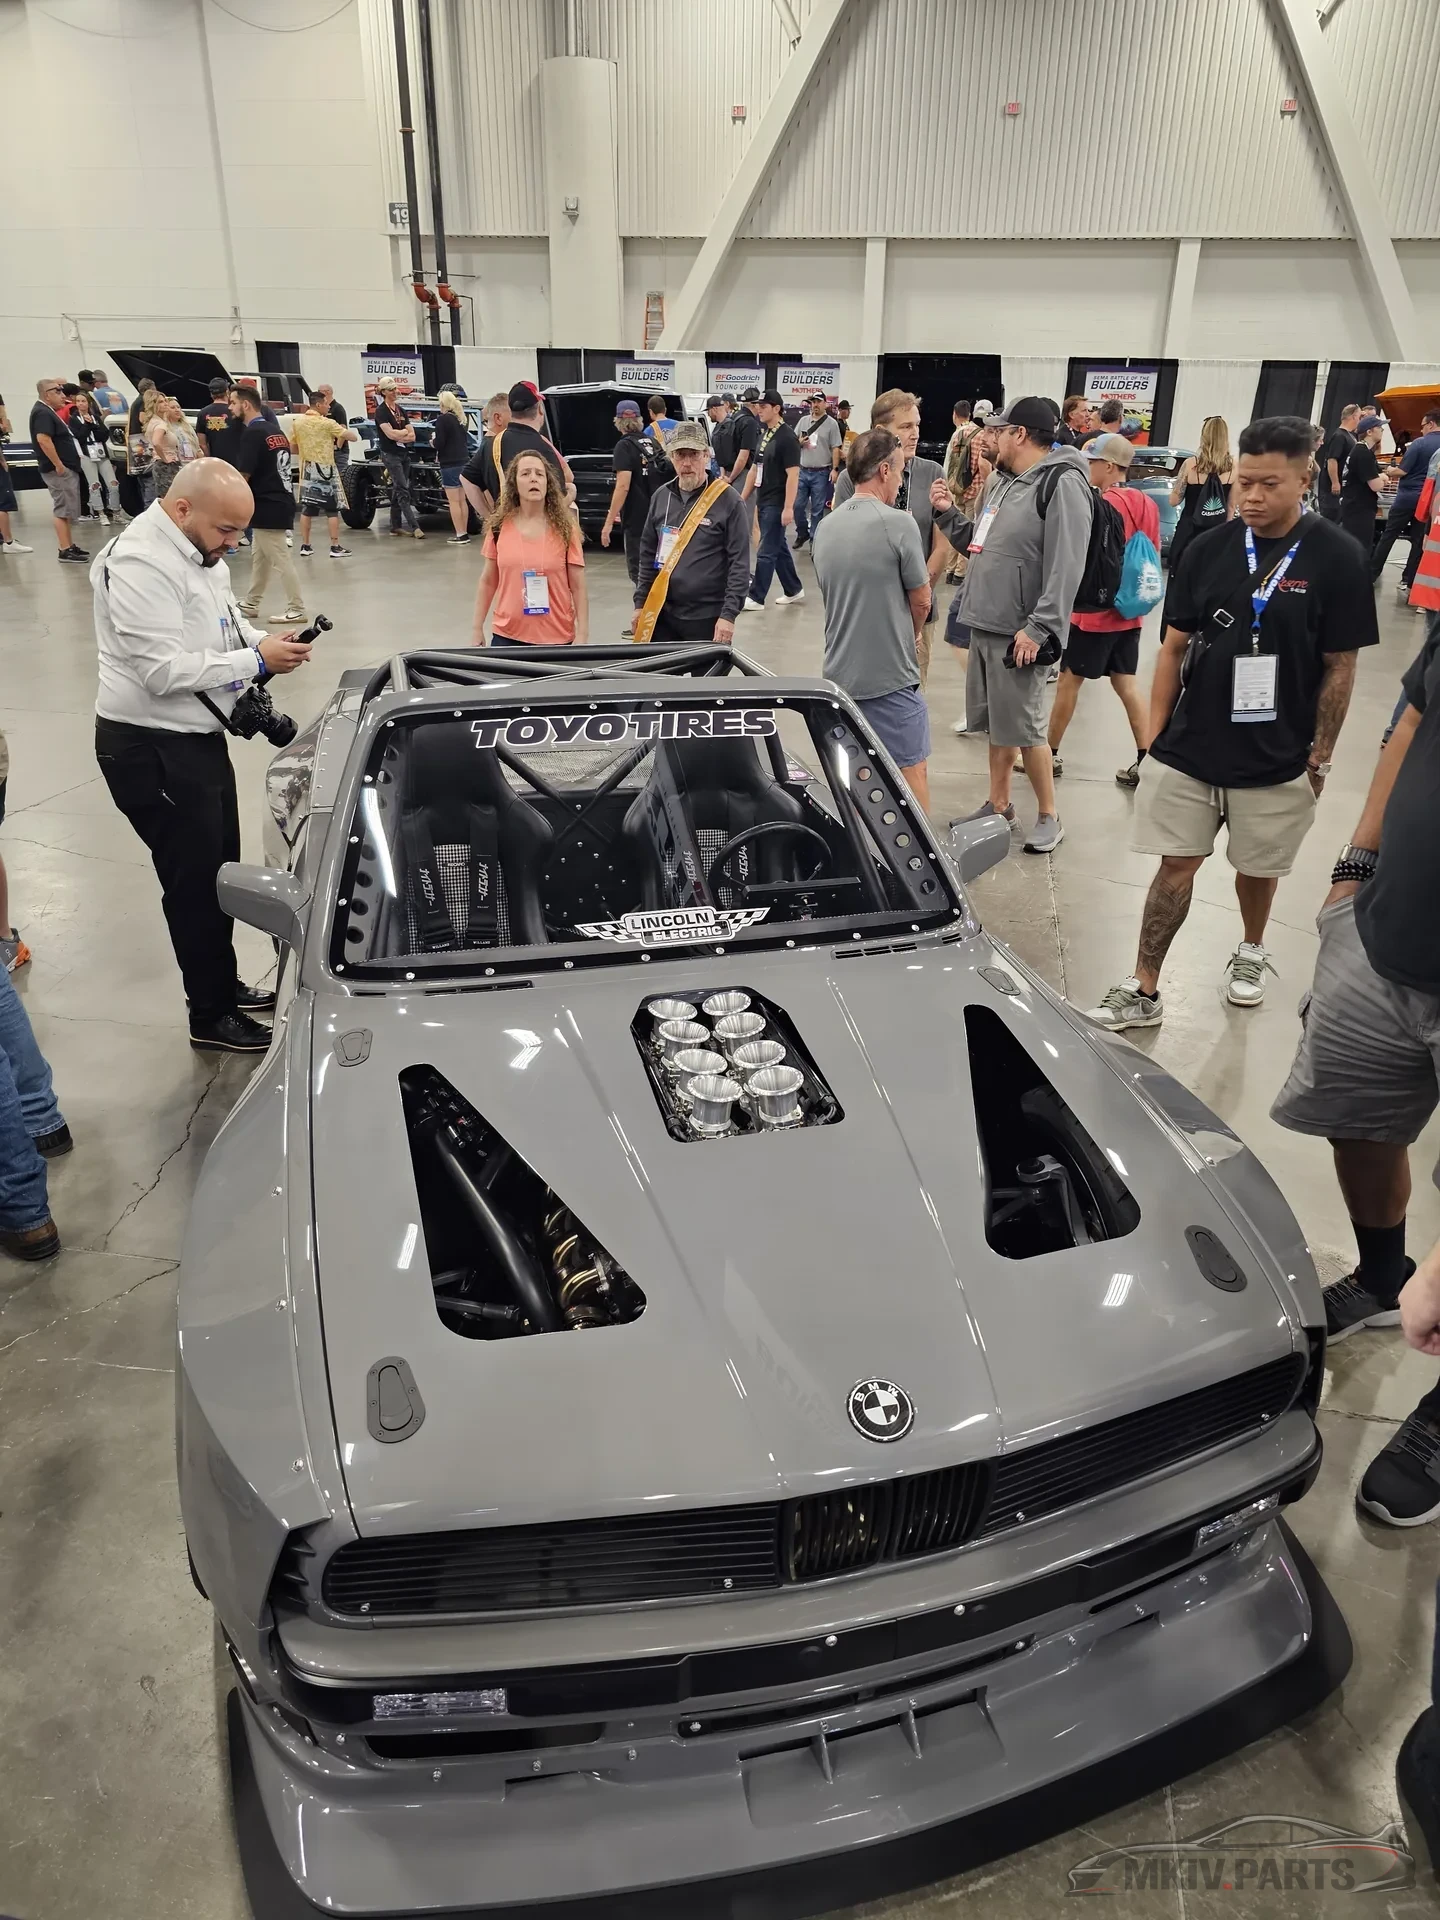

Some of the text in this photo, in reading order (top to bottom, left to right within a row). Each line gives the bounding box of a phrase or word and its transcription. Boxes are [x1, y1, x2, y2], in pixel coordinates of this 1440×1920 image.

[392, 208, 409, 223] 19
[367, 364, 417, 375] BUILDERS
[621, 371, 670, 381] BUILDERS
[782, 375, 834, 385] BUILDERS
[715, 383, 738, 391] YOUNG
[1090, 380, 1149, 390] BUILDERS
[1100, 393, 1136, 401] MOTHERS
[631, 911, 710, 930] LINCOLN
[652, 925, 723, 942] ELECTRIC
[854, 1382, 899, 1402] BMW
